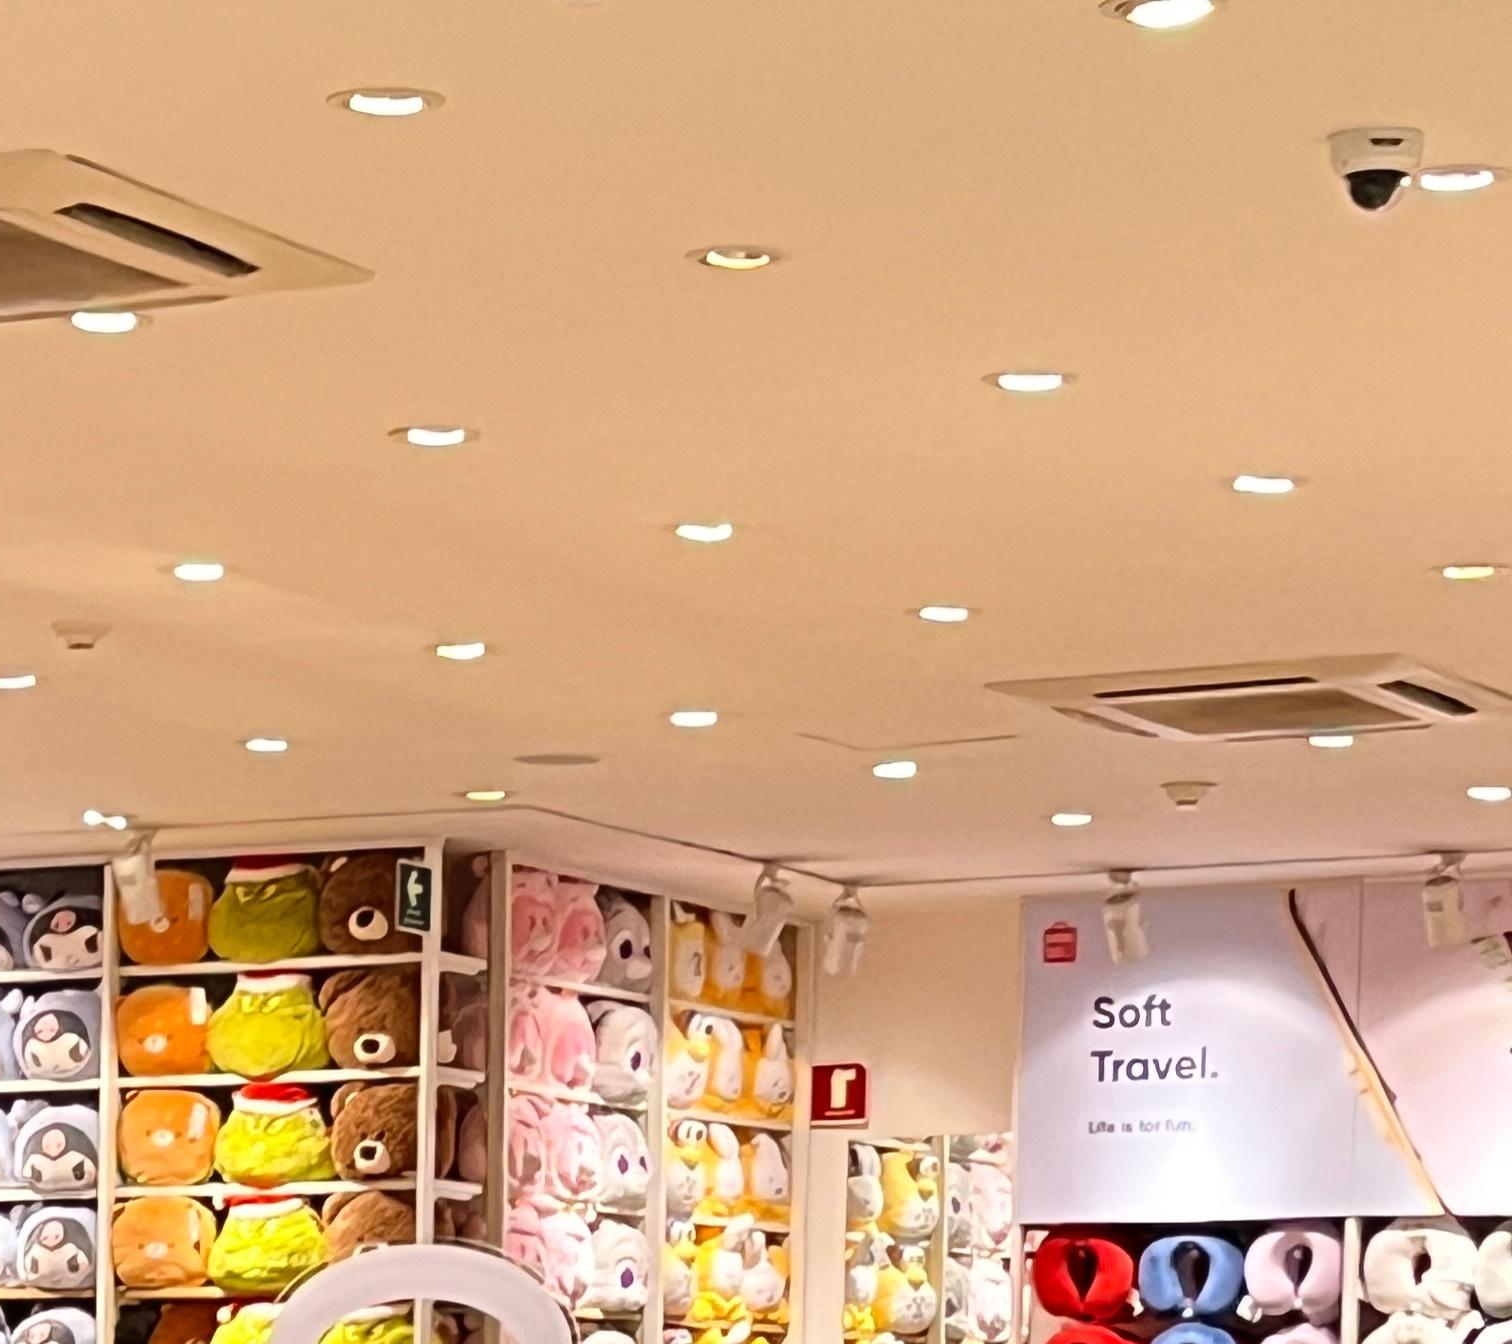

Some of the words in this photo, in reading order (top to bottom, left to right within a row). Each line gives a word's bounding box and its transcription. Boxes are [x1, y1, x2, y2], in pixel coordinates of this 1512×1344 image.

[1092, 994, 1172, 1029] Soft
[1090, 1045, 1219, 1082] Travel.
[1121, 1121, 1133, 1133] is
